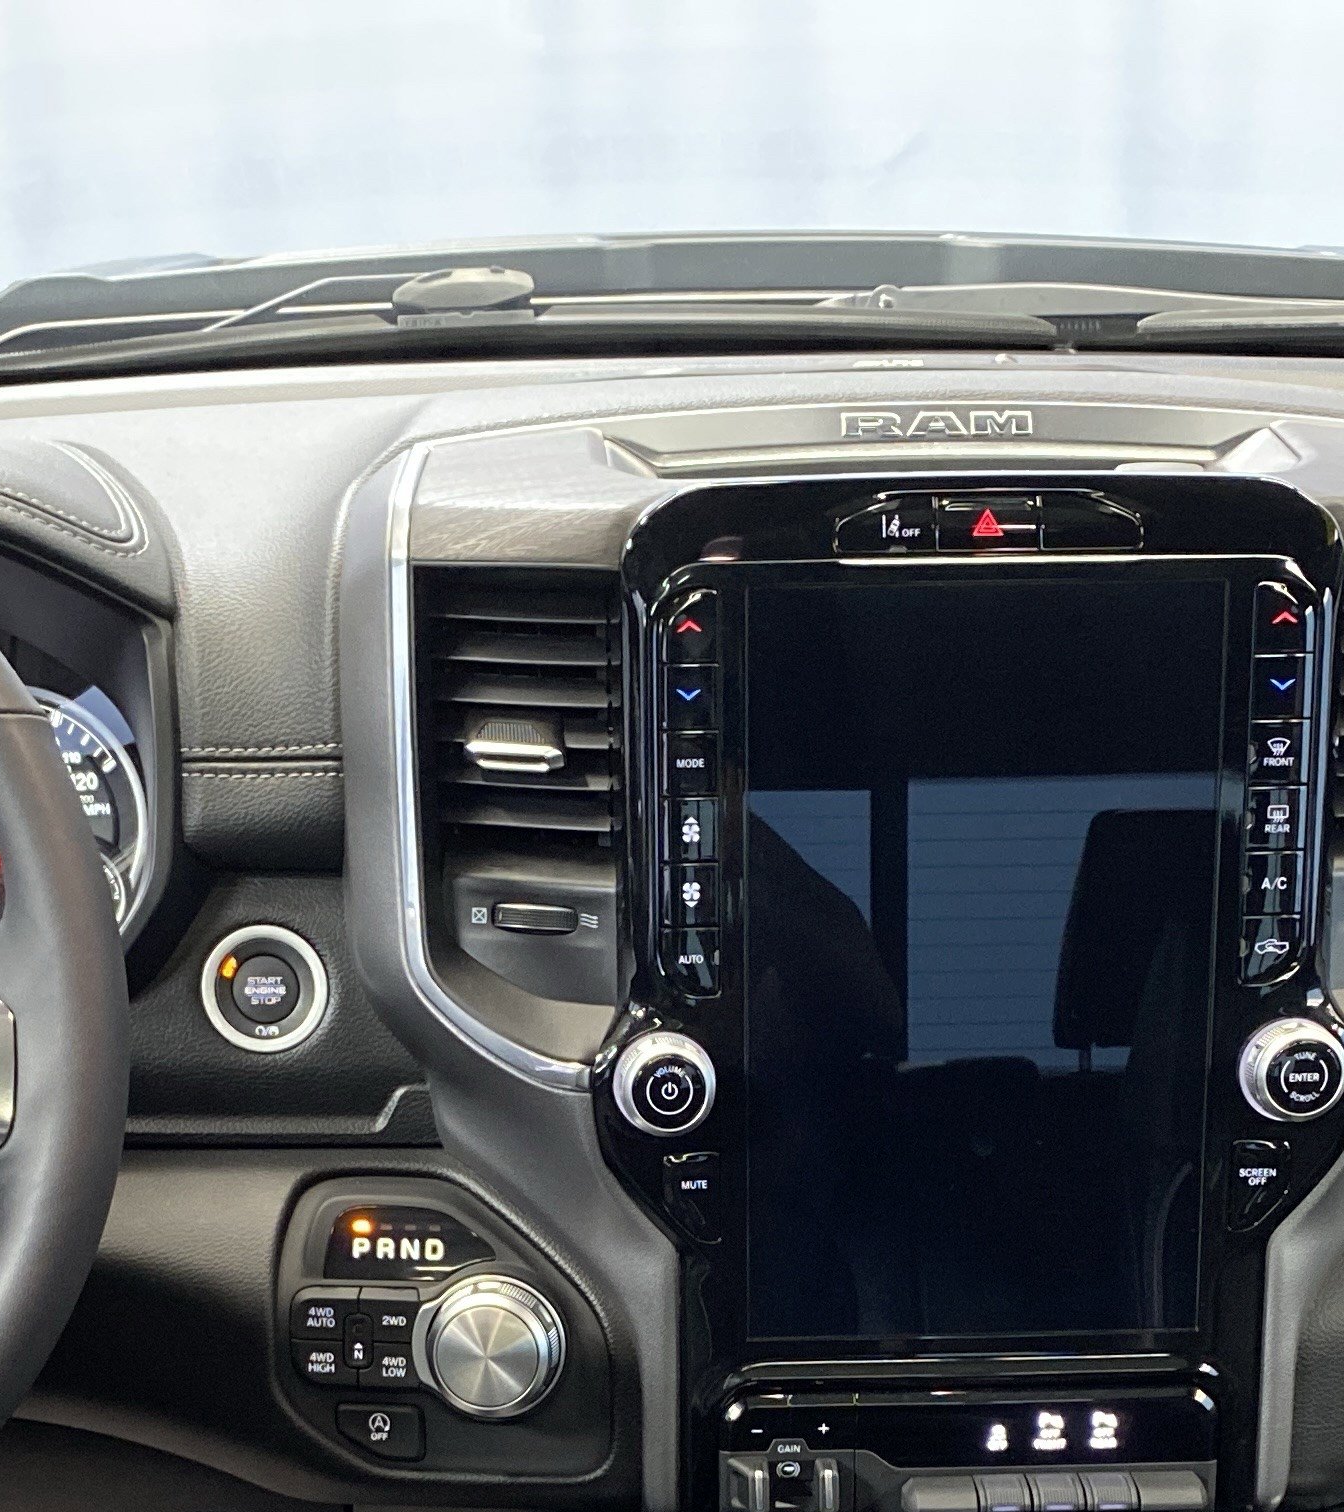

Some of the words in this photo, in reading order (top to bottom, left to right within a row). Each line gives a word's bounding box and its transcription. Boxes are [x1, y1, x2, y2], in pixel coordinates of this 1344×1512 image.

[840, 410, 1033, 437] RAM
[902, 528, 921, 538] OFF
[676, 758, 705, 769] MODE
[1263, 757, 1294, 767] FRONT
[1264, 824, 1290, 834] REAR
[1261, 877, 1287, 890] A/C
[678, 954, 704, 965] AUTO
[247, 976, 283, 985] START
[244, 986, 287, 995] ENGINE
[251, 996, 281, 1005] STOP
[653, 1065, 685, 1078] VOLUME
[1288, 1072, 1320, 1083] ENTER
[1288, 1091, 1320, 1103] SCROLL
[1239, 1168, 1277, 1177] SCREEN
[681, 1180, 708, 1190] MUTE
[1248, 1177, 1267, 1186] OFF
[308, 1307, 334, 1318] 4WD
[306, 1317, 335, 1328] AUTO
[382, 1316, 406, 1327] 2WD
[309, 1352, 335, 1363] 4WD
[354, 1350, 363, 1360] N
[307, 1362, 335, 1373] HIGH
[382, 1357, 406, 1368] 4WD
[382, 1366, 406, 1377] LOW
[370, 1432, 388, 1441] OFF
[777, 1444, 801, 1454] GAIN
